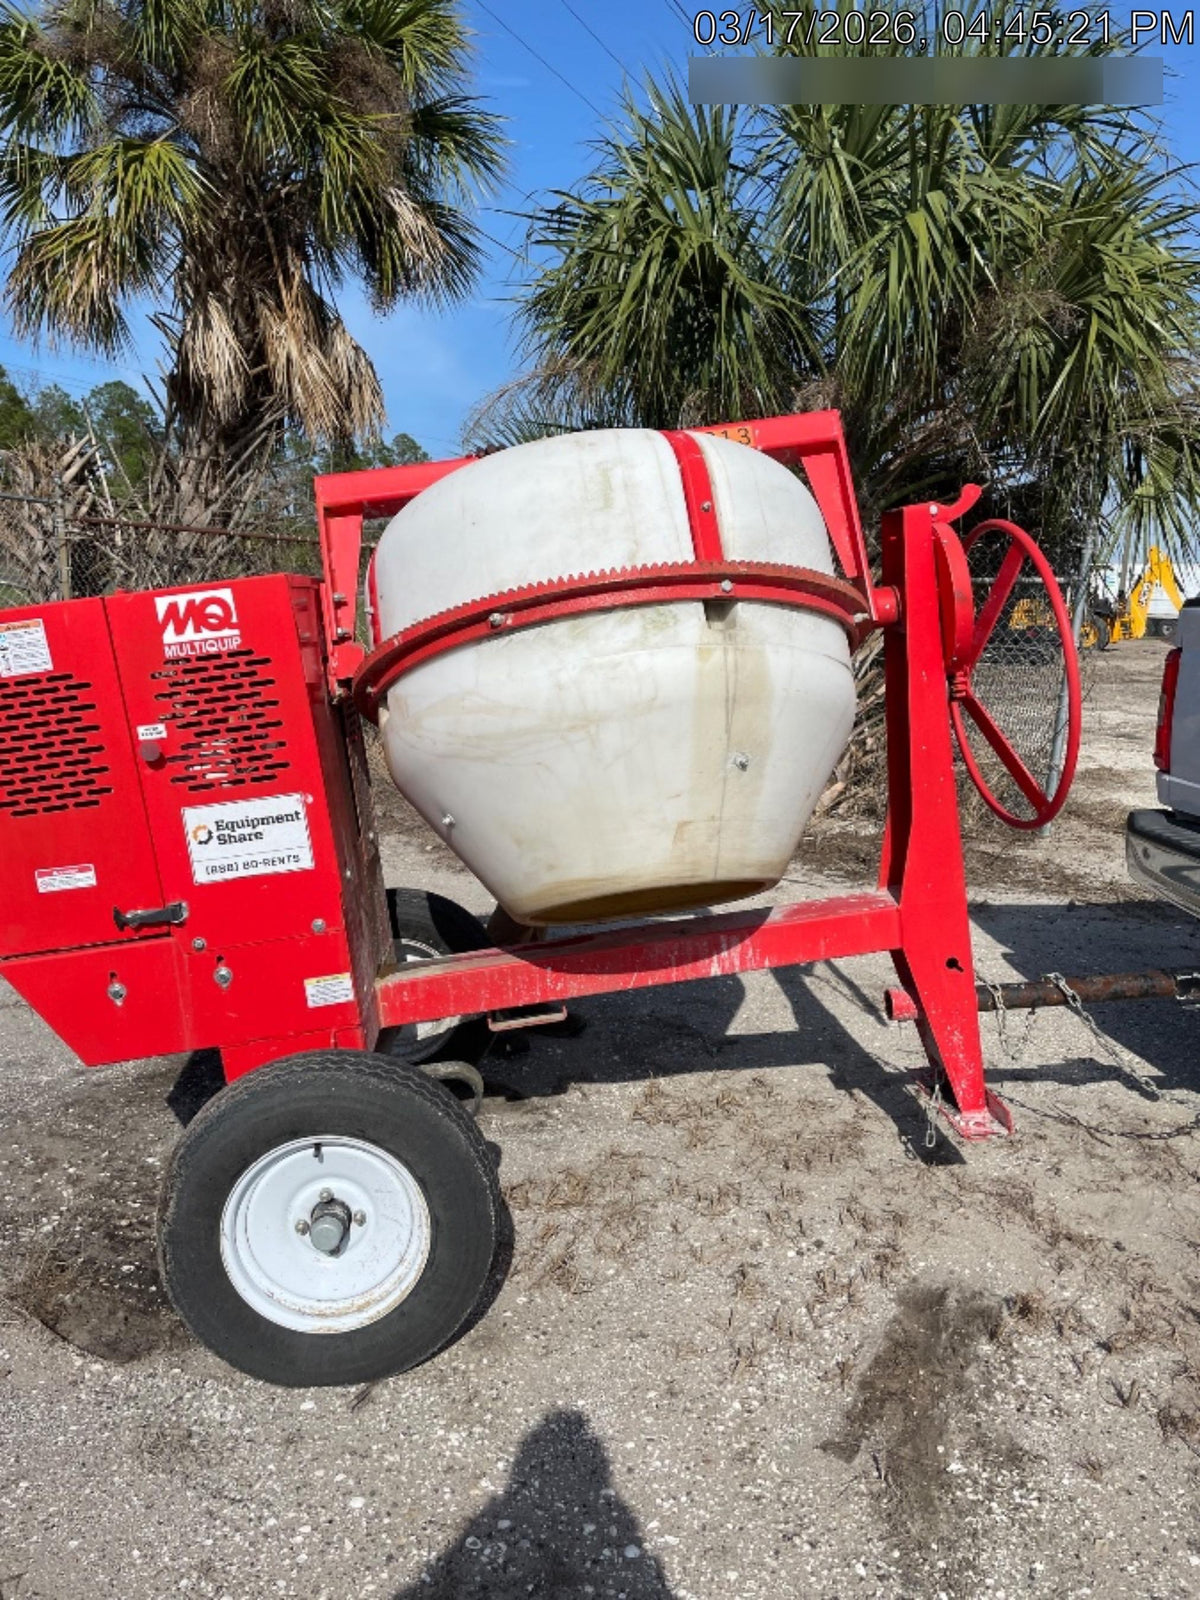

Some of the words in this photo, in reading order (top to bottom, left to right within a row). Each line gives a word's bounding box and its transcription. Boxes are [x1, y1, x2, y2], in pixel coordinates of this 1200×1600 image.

[705, 427, 751, 446] 13
[157, 594, 240, 637] MQ
[163, 636, 241, 659] MULTIQUIP
[214, 810, 302, 832] Equipment
[216, 831, 264, 845] Share
